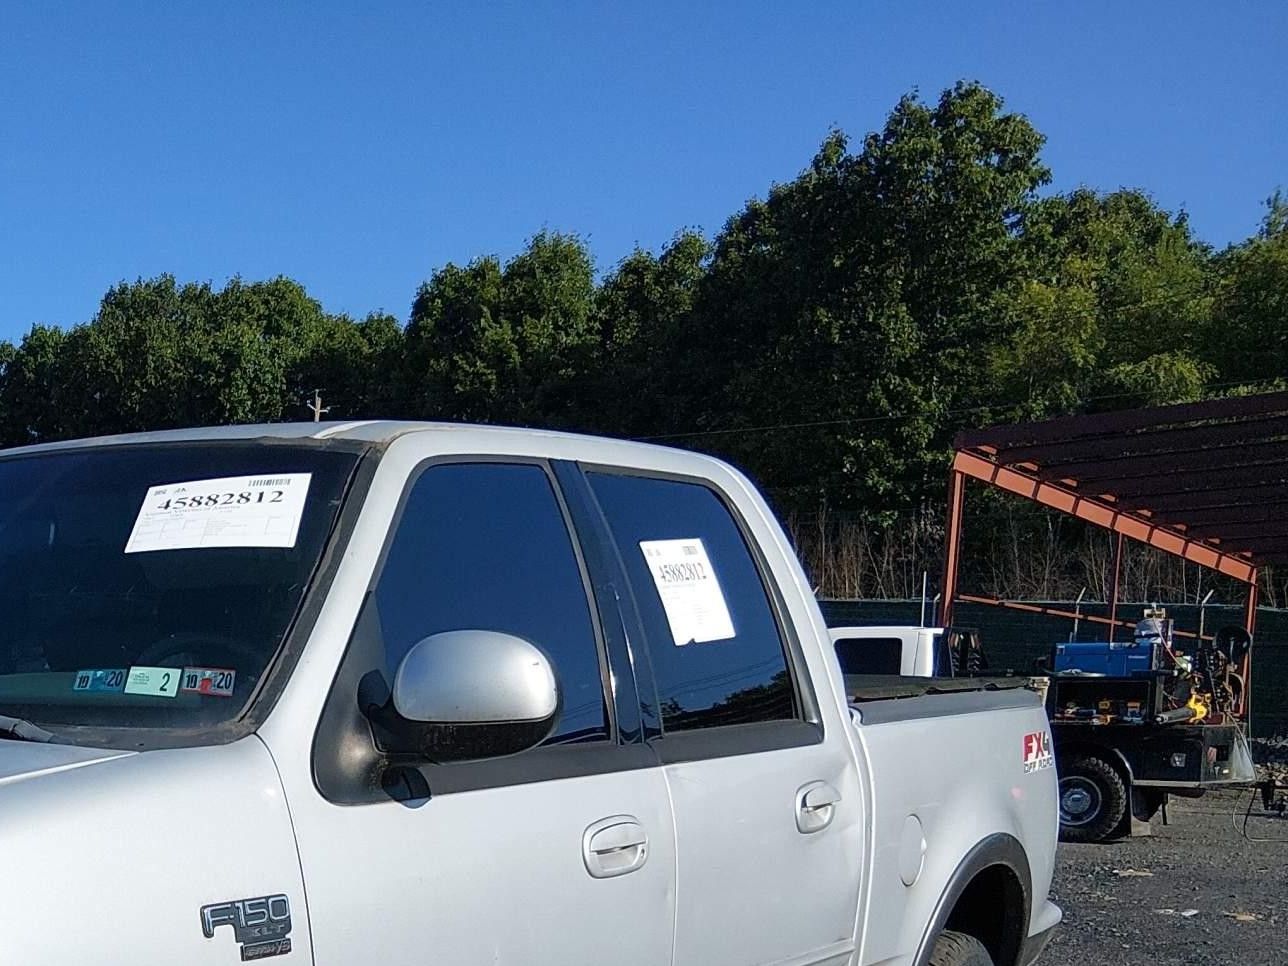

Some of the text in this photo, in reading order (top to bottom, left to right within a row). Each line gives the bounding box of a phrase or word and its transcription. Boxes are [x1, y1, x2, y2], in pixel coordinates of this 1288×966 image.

[157, 490, 284, 511] 45882812
[658, 561, 707, 583] 45882812
[107, 671, 124, 688] 20
[159, 672, 171, 692] 2
[216, 672, 232, 690] 20
[1023, 731, 1051, 762] FX4
